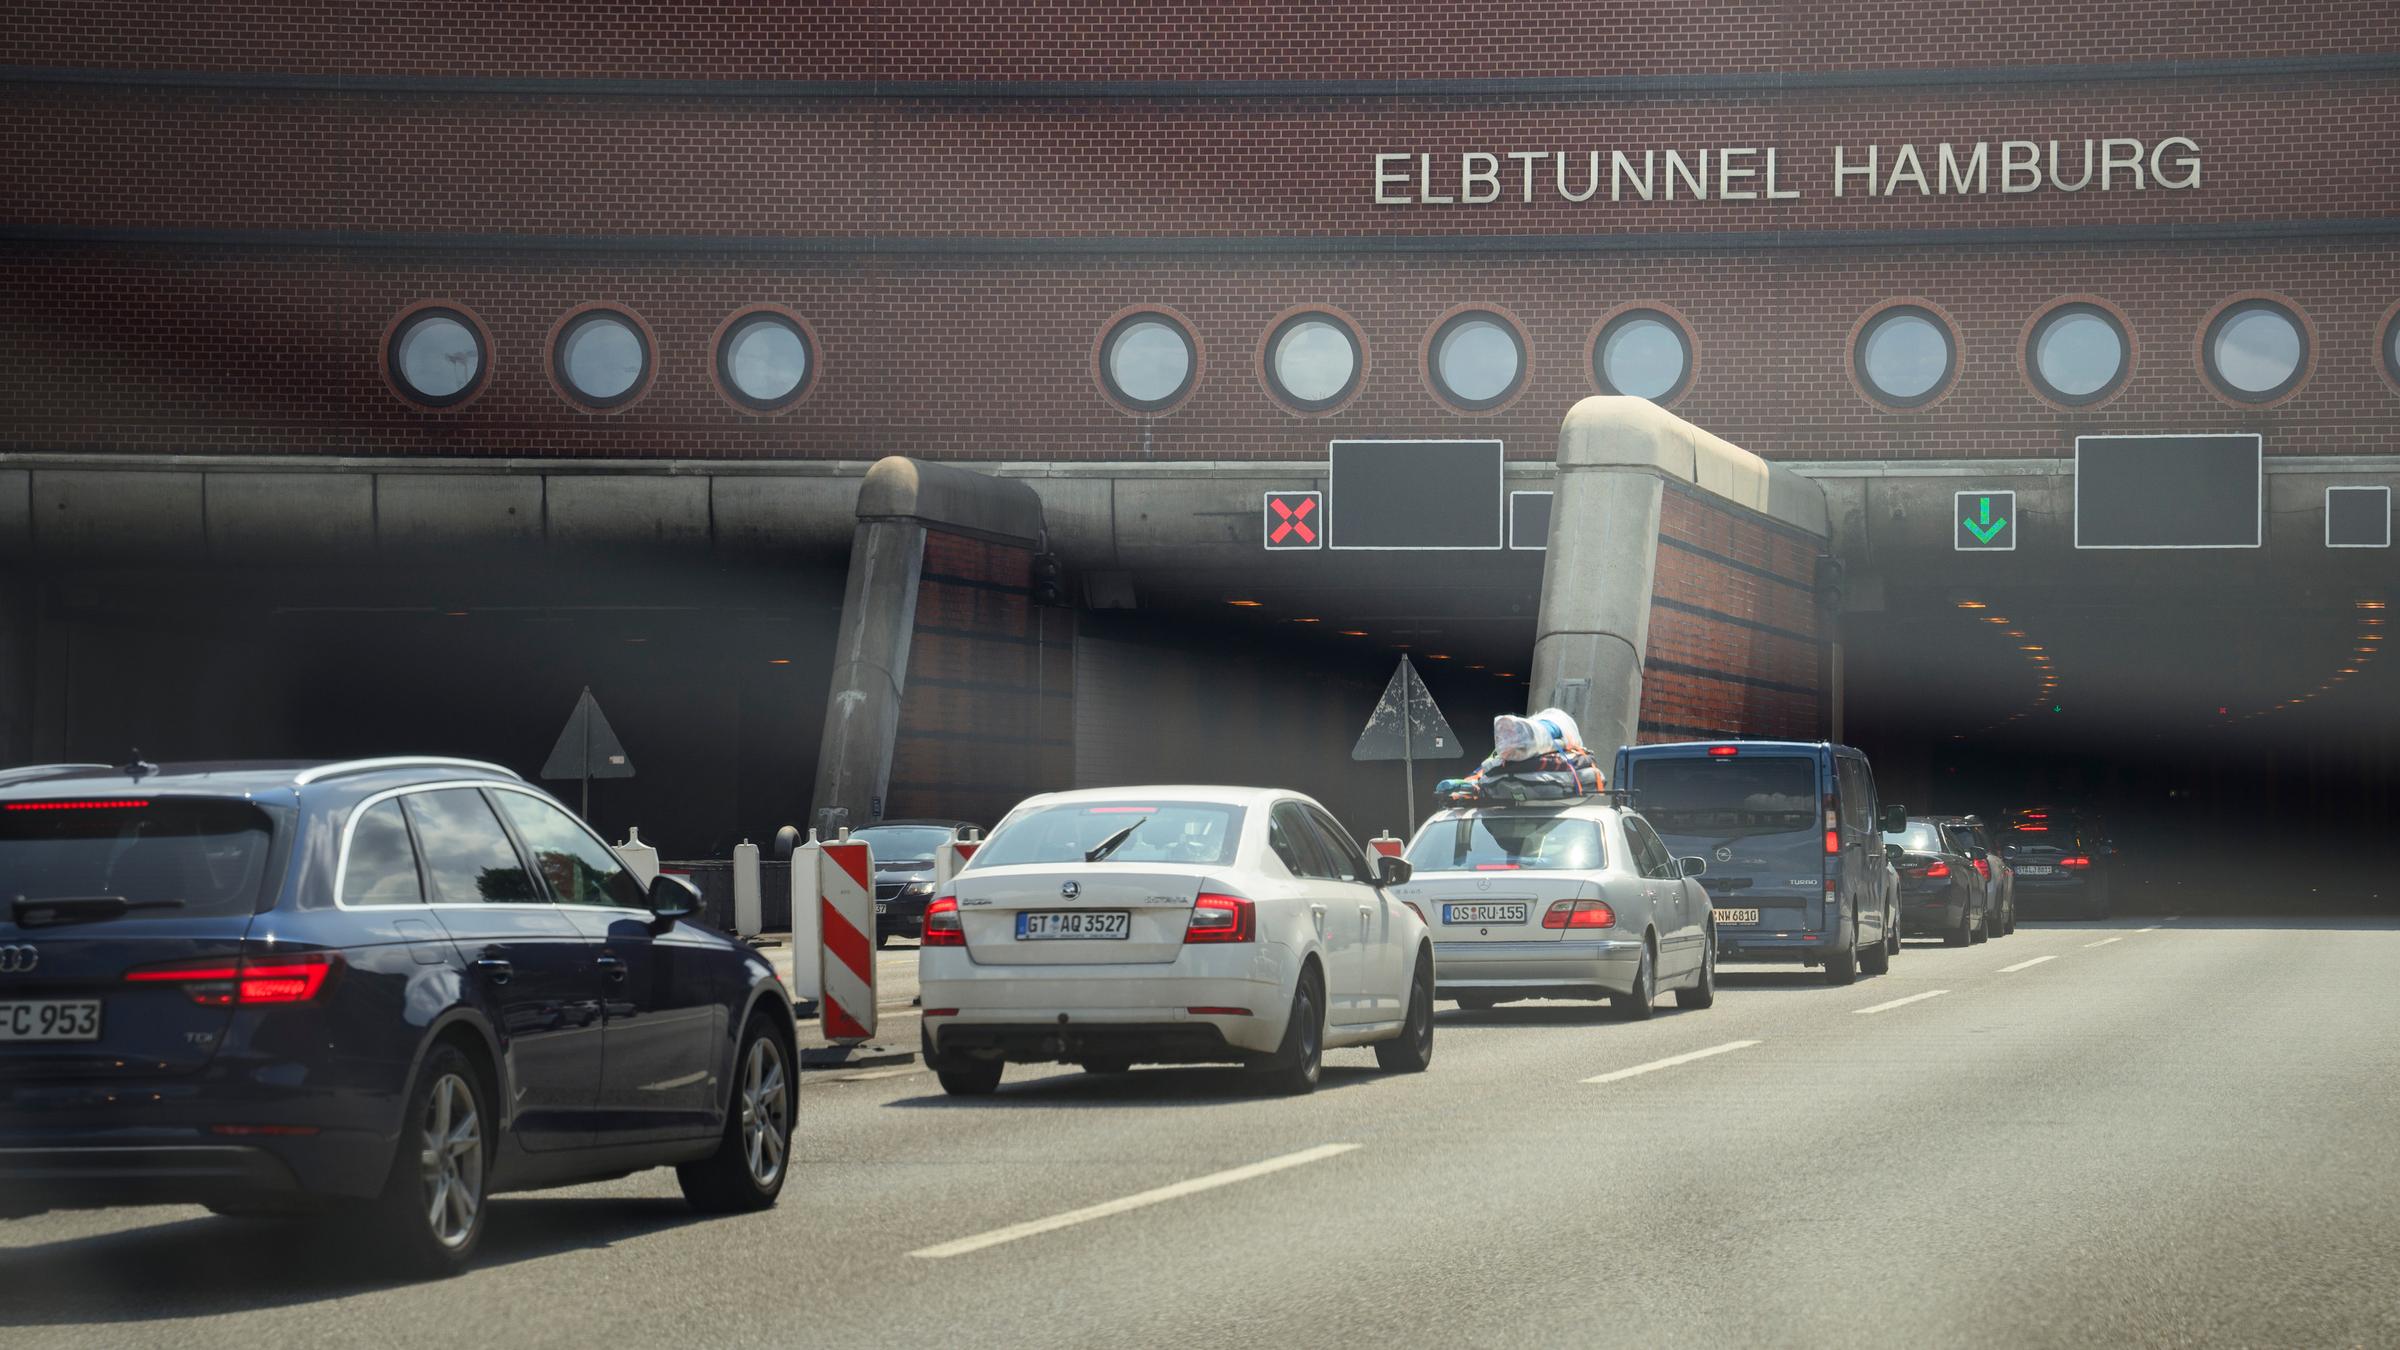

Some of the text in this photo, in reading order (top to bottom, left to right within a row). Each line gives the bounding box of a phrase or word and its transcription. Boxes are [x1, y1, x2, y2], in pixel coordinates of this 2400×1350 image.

[1375, 136, 2200, 204] ELBTUNNEL HAMBURG
[1452, 906, 1524, 919] OS RU 155
[1732, 910, 1756, 921] 6810
[1028, 914, 1126, 933] GT AQ 3527
[40, 1004, 97, 1035] 953
